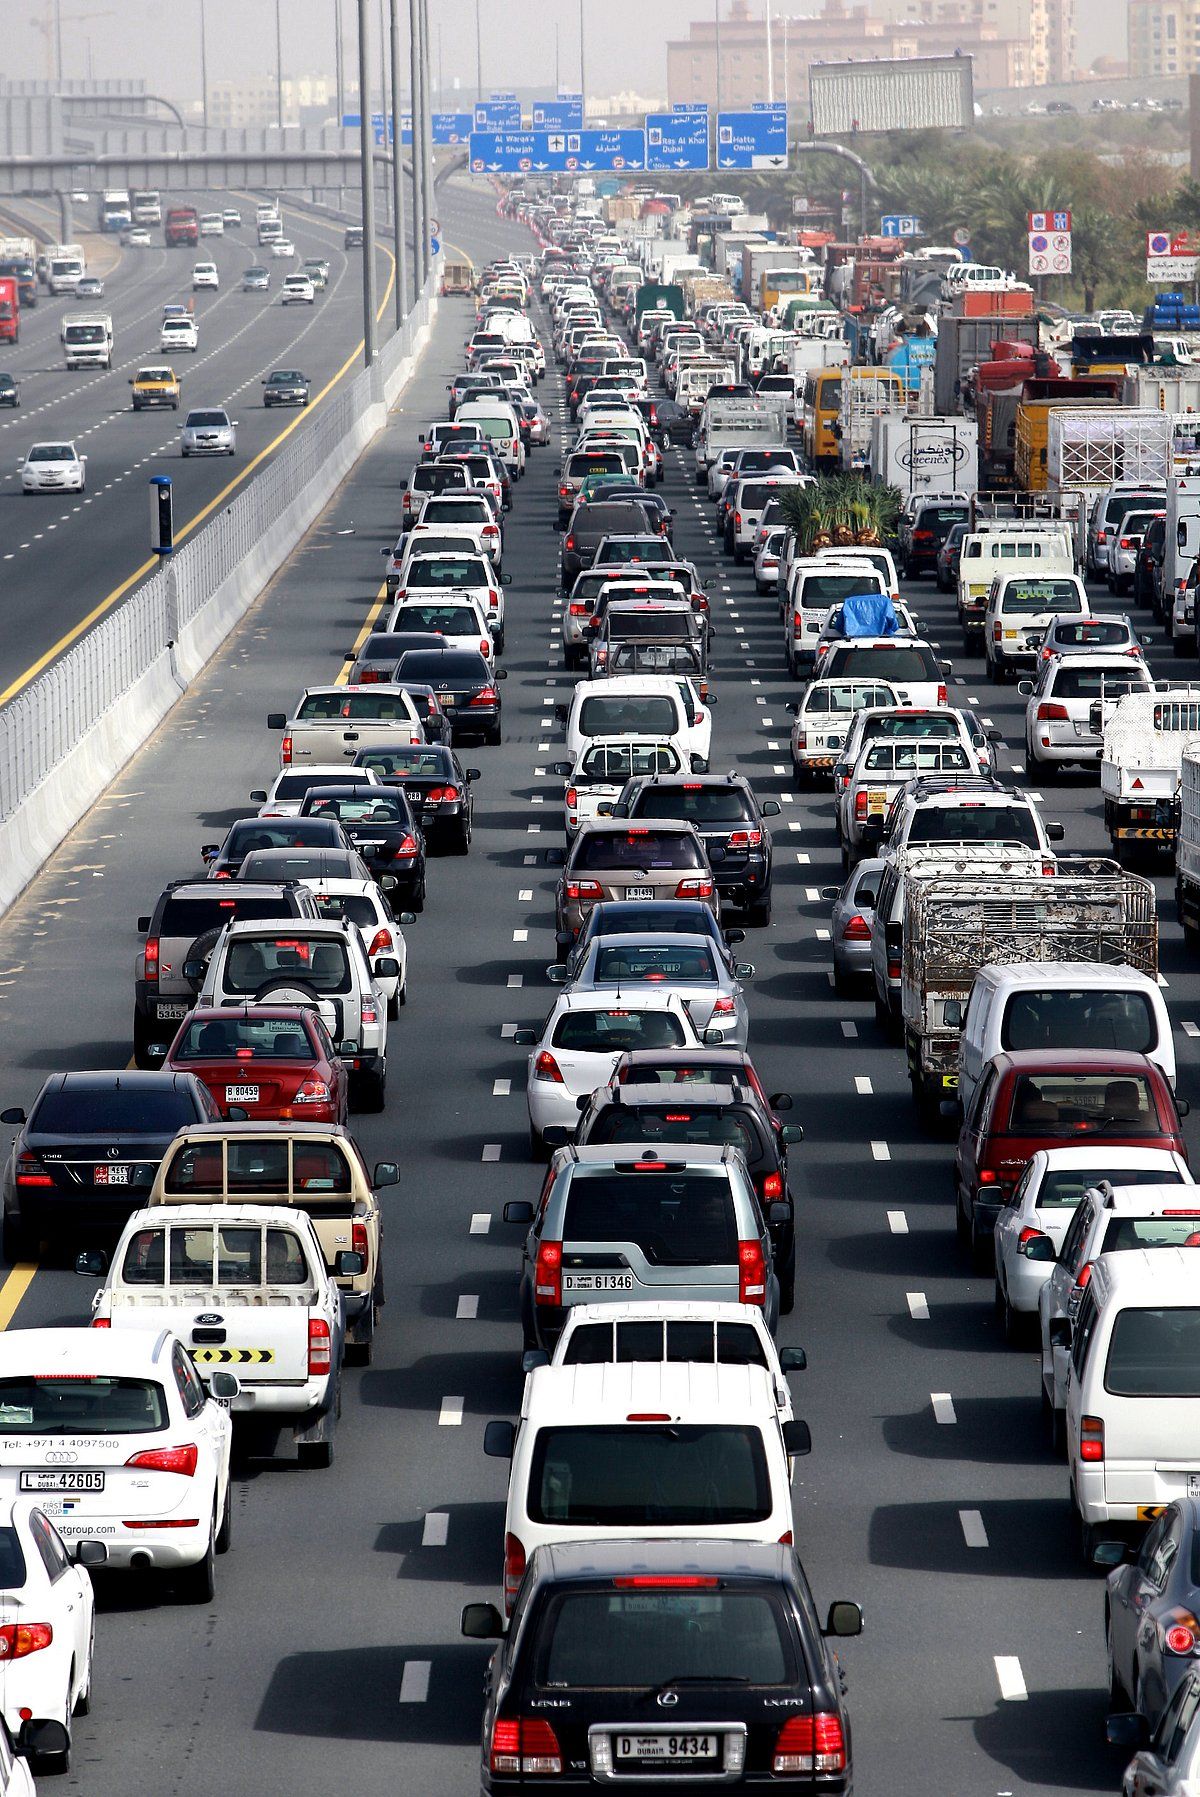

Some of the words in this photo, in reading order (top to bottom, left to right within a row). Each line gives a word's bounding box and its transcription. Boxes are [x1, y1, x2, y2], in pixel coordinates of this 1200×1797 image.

[495, 135, 503, 143] Al
[662, 137, 676, 145] Ras
[688, 136, 705, 144] Khor
[732, 136, 755, 144] Hatta
[662, 145, 683, 153] Dubai
[733, 144, 755, 152] Oman
[901, 453, 949, 468] Queenex
[235, 1086, 258, 1096] 80459
[566, 1276, 573, 1289] D
[595, 1276, 632, 1289] 61346
[3, 1440, 22, 1449] Tel:
[26, 1439, 54, 1448] +971
[59, 1439, 65, 1447] 4
[70, 1439, 119, 1448] 4097500
[26, 1474, 32, 1487] L
[60, 1473, 102, 1488] 42605
[57, 1525, 116, 1535] stgroup.com
[622, 1738, 631, 1755] D
[669, 1737, 709, 1755] 9434
